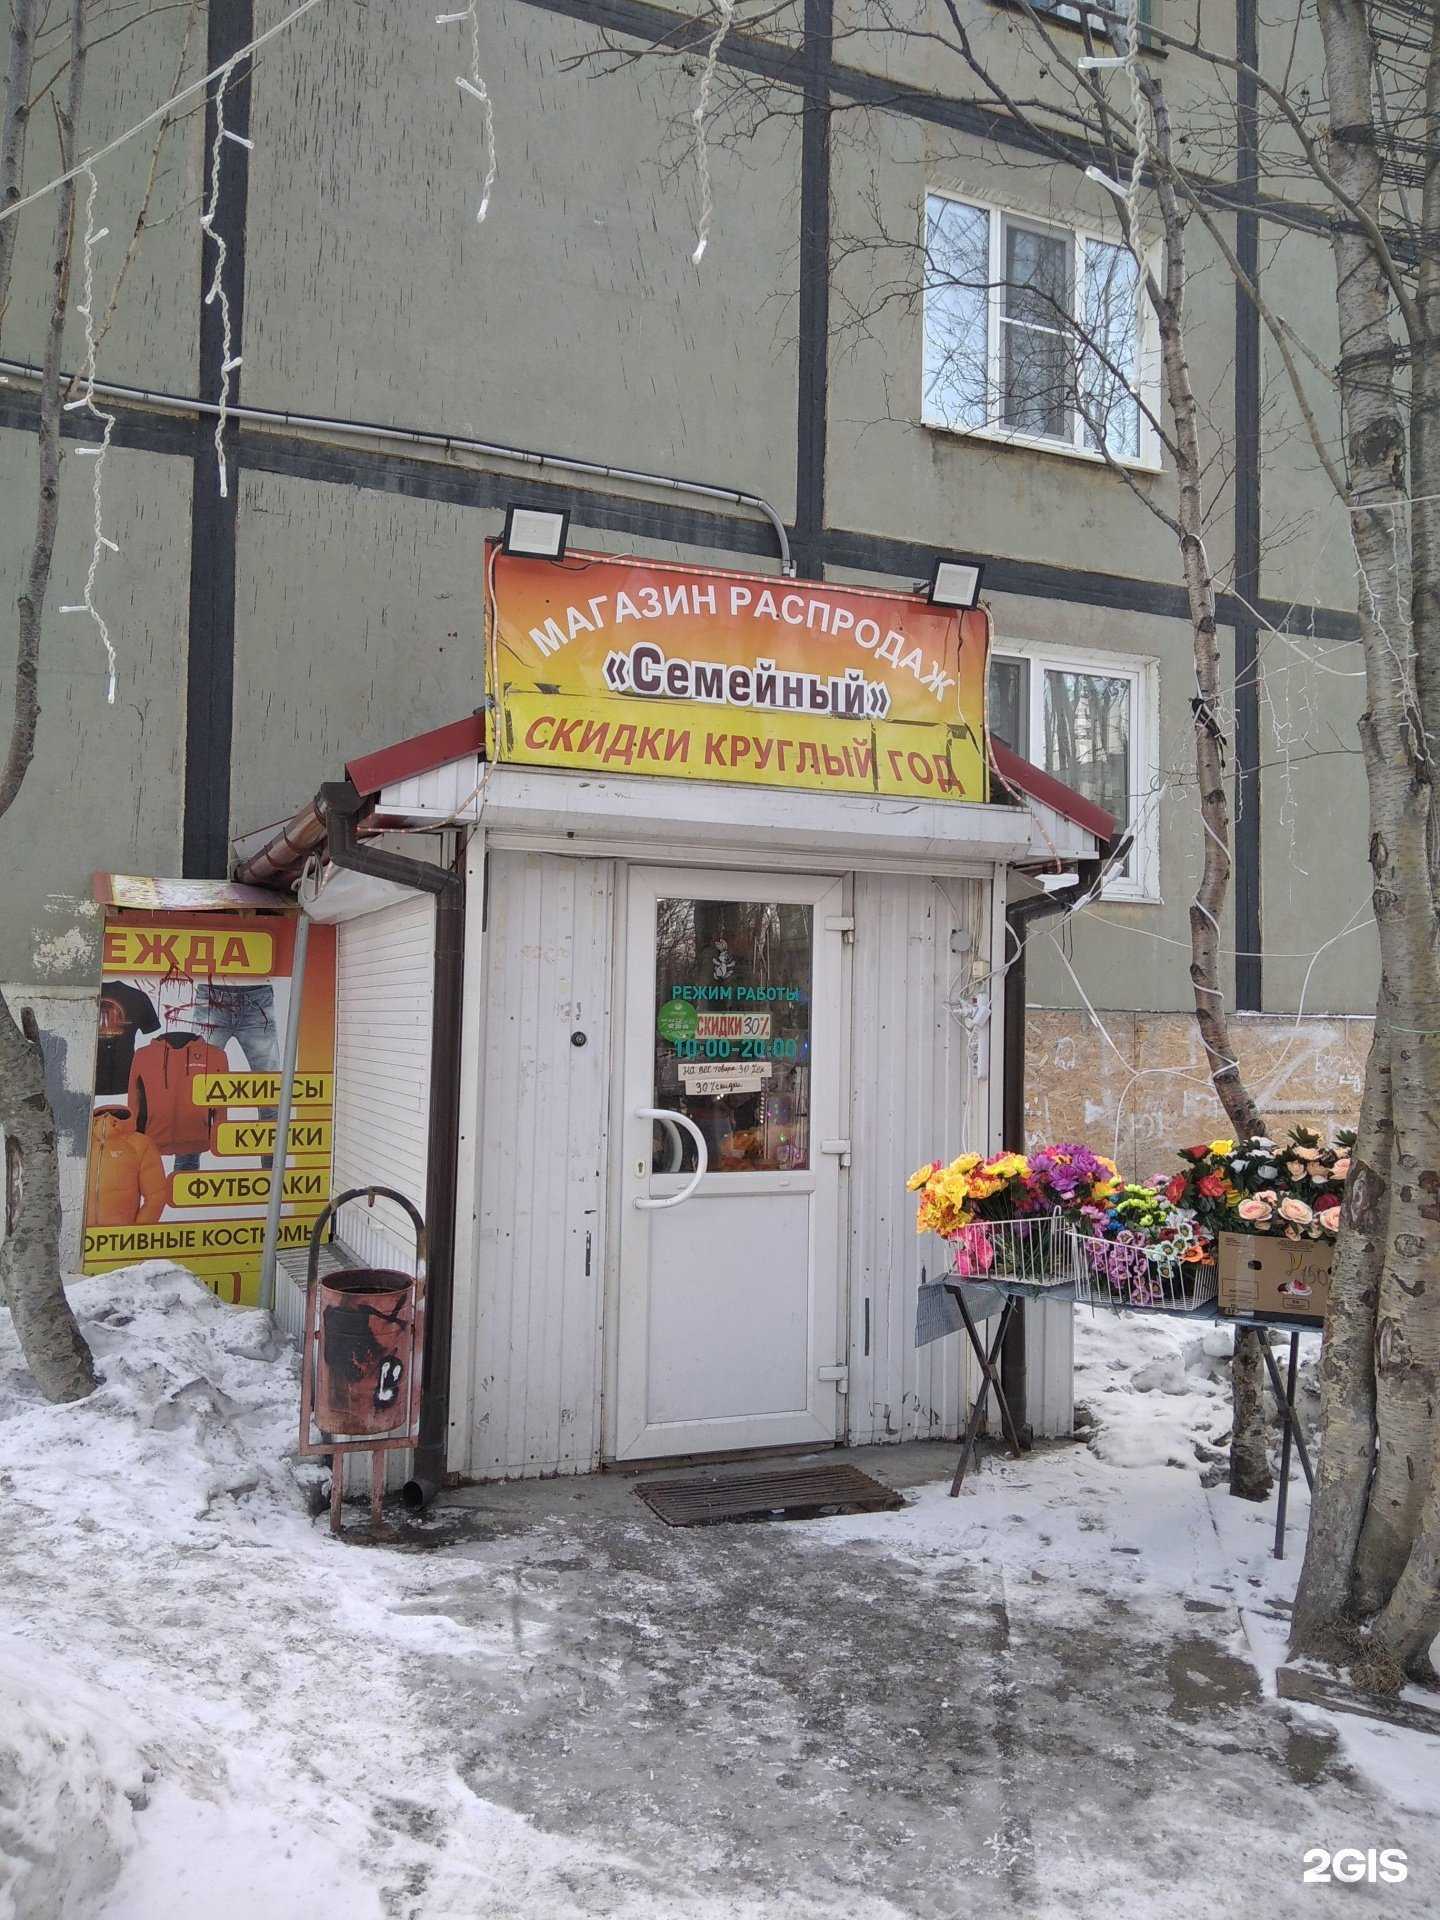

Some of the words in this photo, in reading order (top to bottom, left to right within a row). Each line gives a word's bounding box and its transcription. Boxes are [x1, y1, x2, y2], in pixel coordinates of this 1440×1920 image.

[528, 584, 717, 657] МАГАЗИН
[729, 586, 957, 703] РАСПРОДАЖ
[604, 644, 890, 717] «Семейный»
[524, 716, 691, 766] СКИДКИ
[704, 732, 877, 780] КРУГЛЫЙ
[888, 750, 967, 797] ГОД
[103, 932, 250, 974] ЕЖДА
[672, 985, 733, 1001] РЕЖИМ
[737, 986, 800, 1001] РАБОТЫ
[697, 1015, 742, 1037] СКИДКИ
[743, 1017, 769, 1036] 30%
[206, 1080, 324, 1102] ДЖИНСЫ
[235, 1127, 323, 1148] КУРКИ
